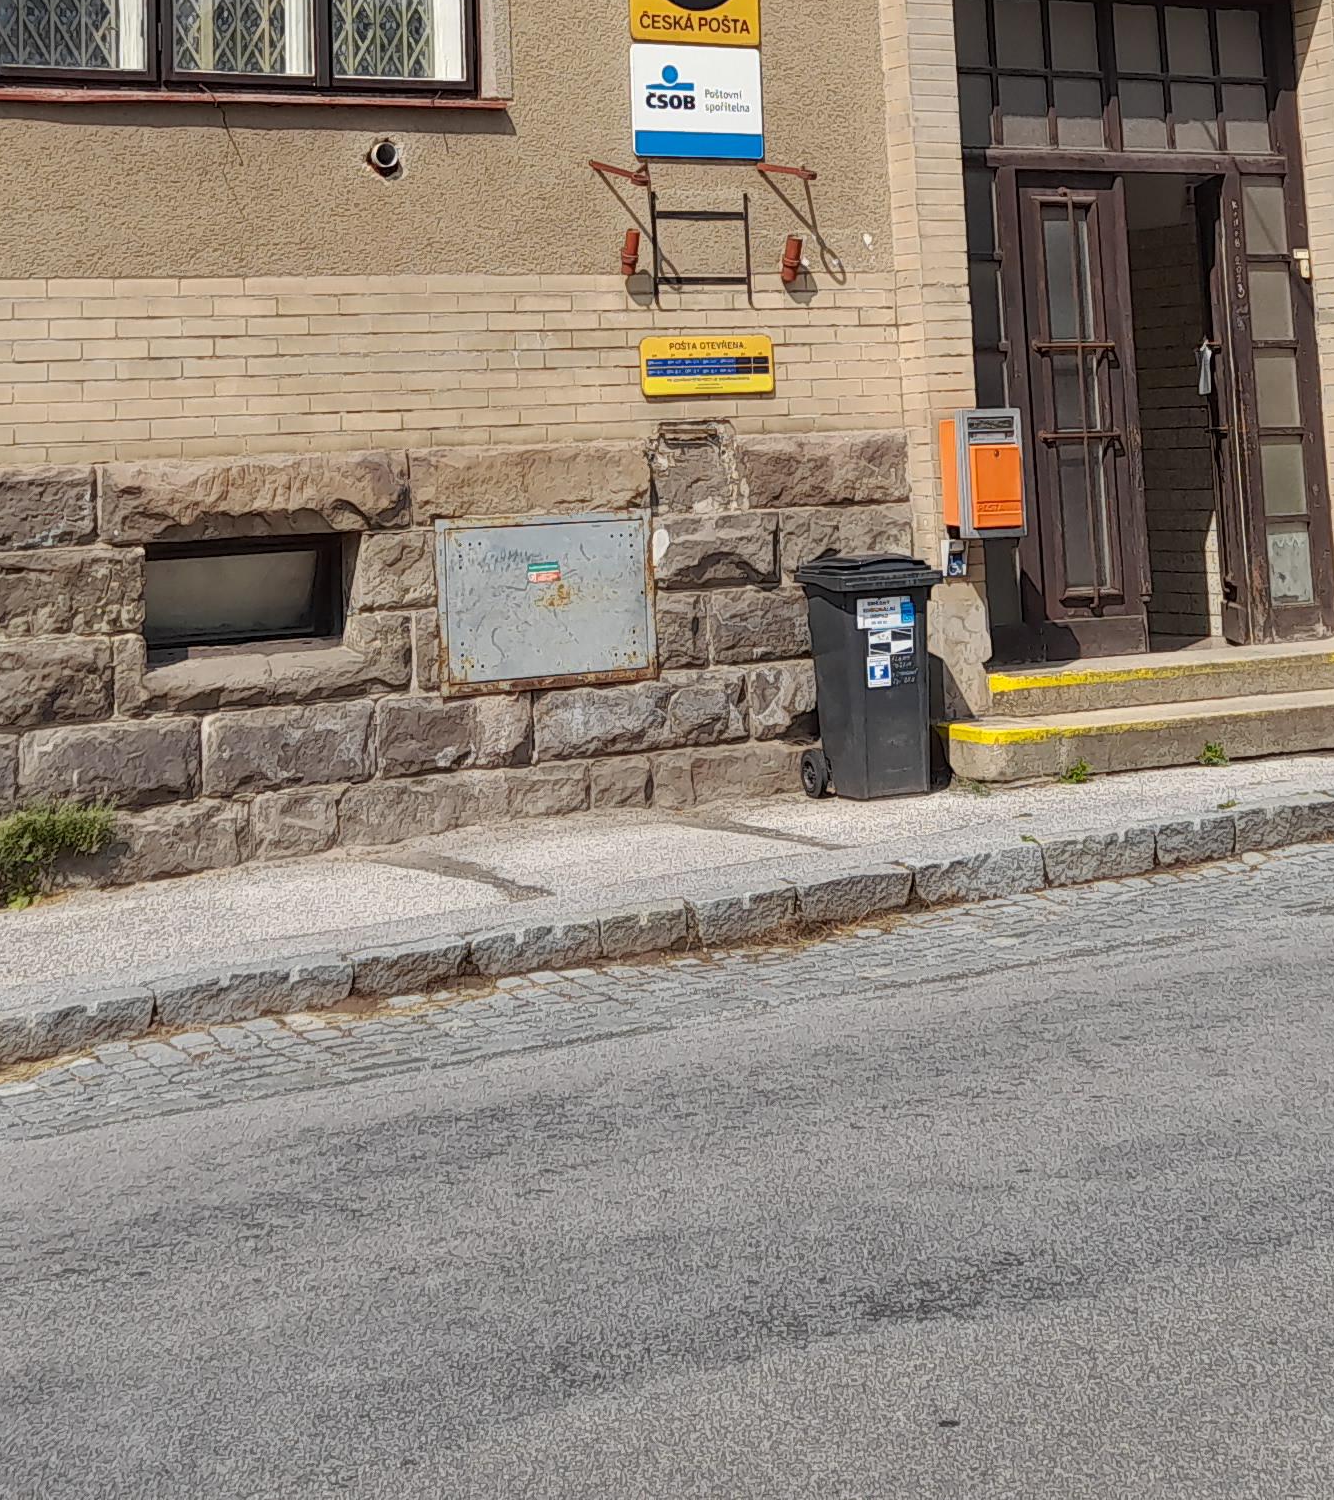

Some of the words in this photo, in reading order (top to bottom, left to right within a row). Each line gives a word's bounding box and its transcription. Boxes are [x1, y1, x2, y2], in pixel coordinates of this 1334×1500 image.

[639, 11, 695, 32] ČESKÁ
[698, 14, 751, 35] POŠTA
[704, 88, 742, 100] Poštovní
[645, 91, 696, 111] ČSOB
[705, 102, 750, 114] spořitelna
[668, 340, 698, 351] POŠTA
[699, 339, 745, 350] OTEVŘENA
